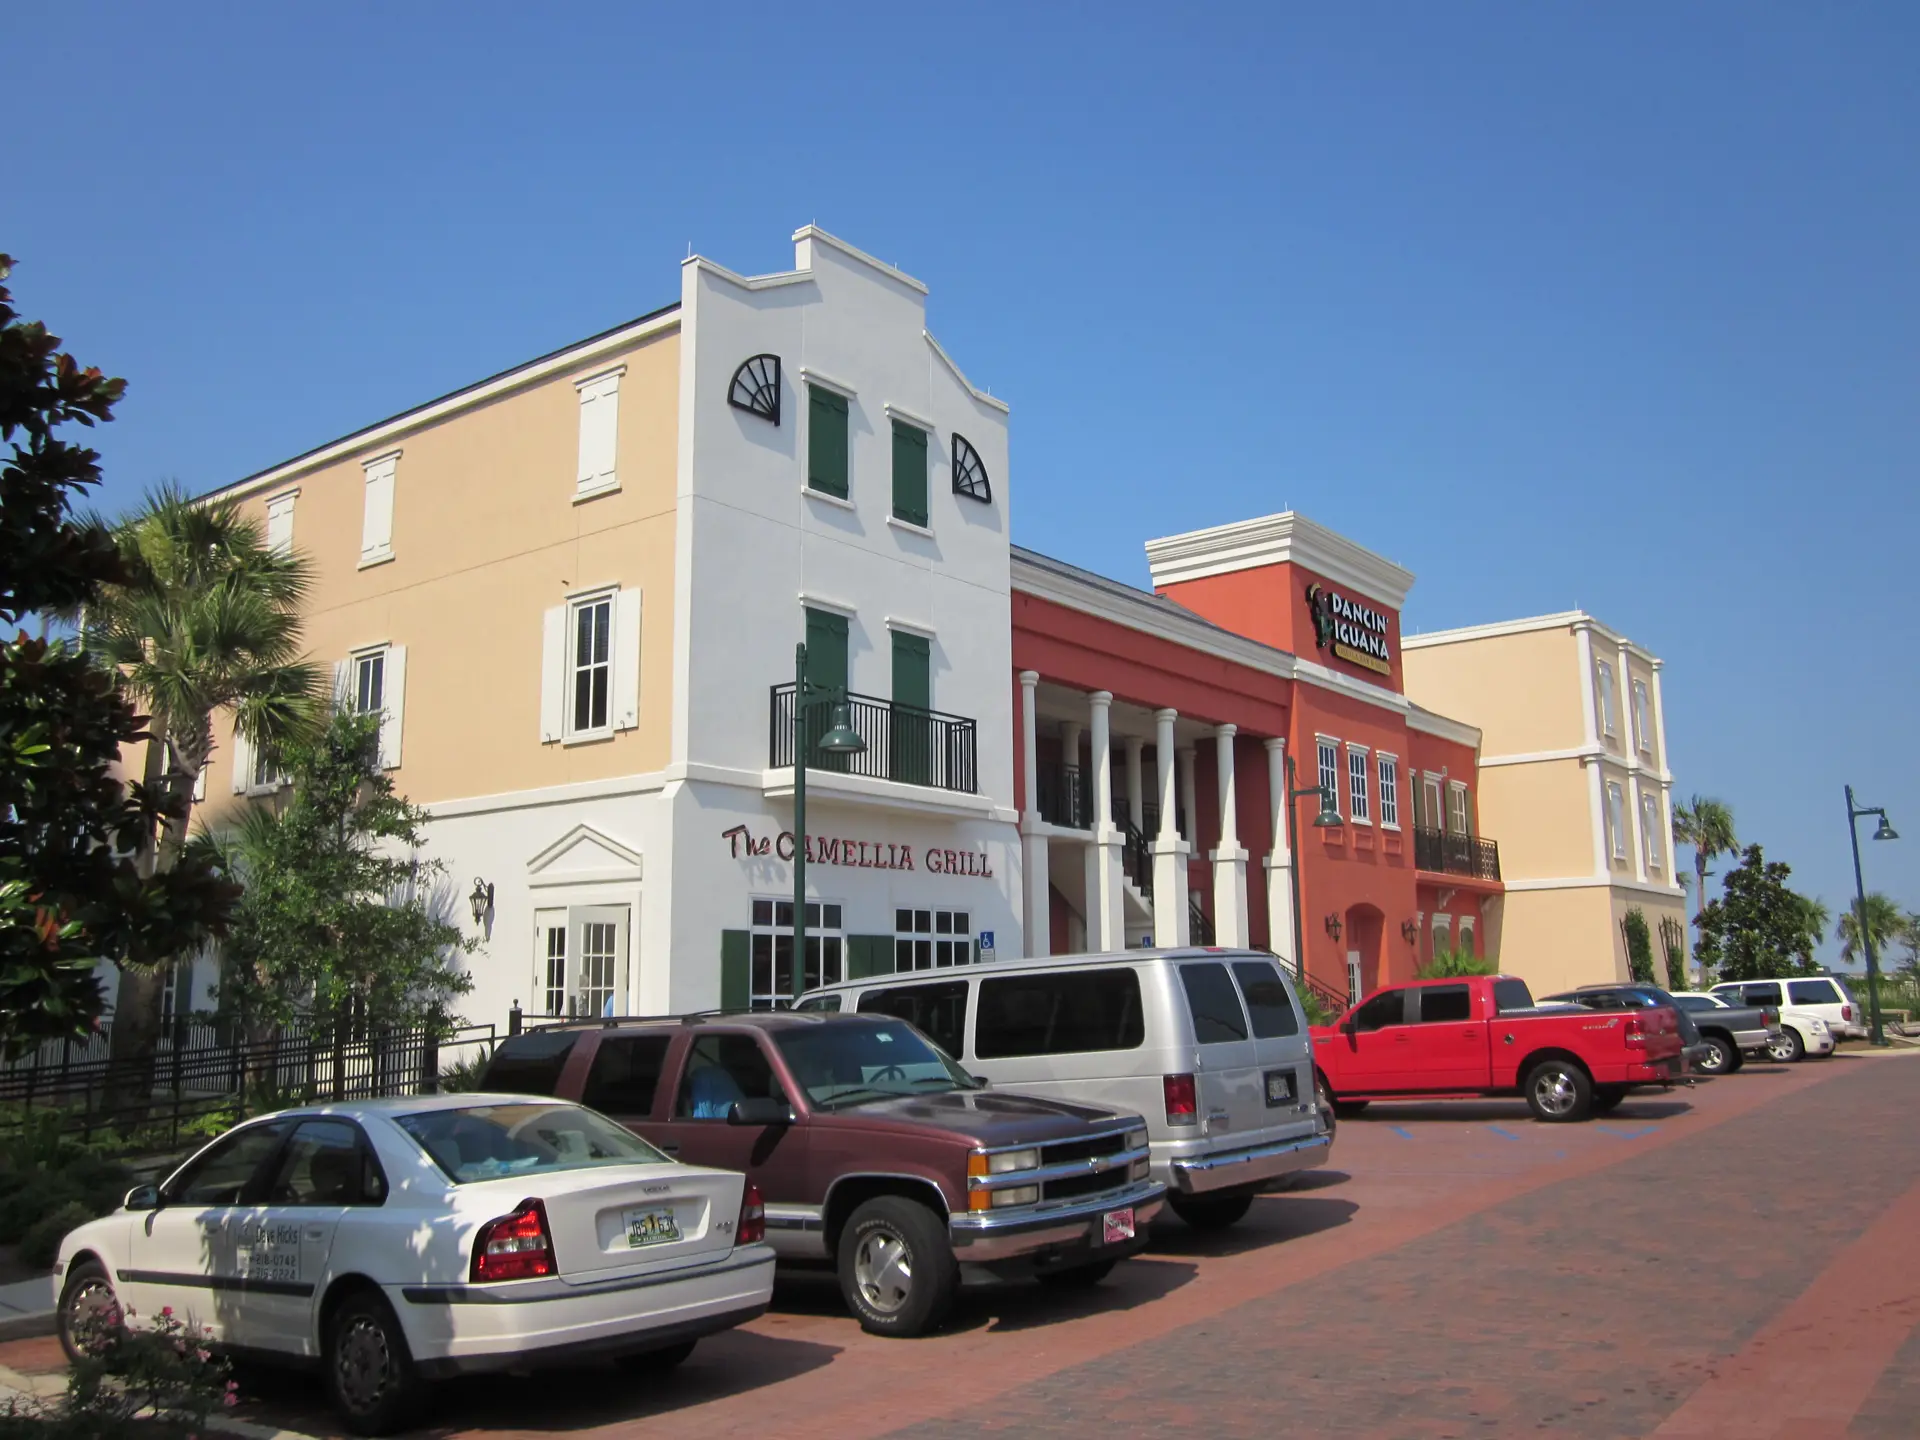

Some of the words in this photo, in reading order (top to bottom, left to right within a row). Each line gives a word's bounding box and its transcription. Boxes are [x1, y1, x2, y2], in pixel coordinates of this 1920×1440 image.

[1334, 618, 1390, 661] IGUANA
[721, 824, 771, 859] The
[775, 831, 915, 871] CAMELLIA
[925, 848, 993, 878] GRILL
[277, 1224, 298, 1245] Hicks
